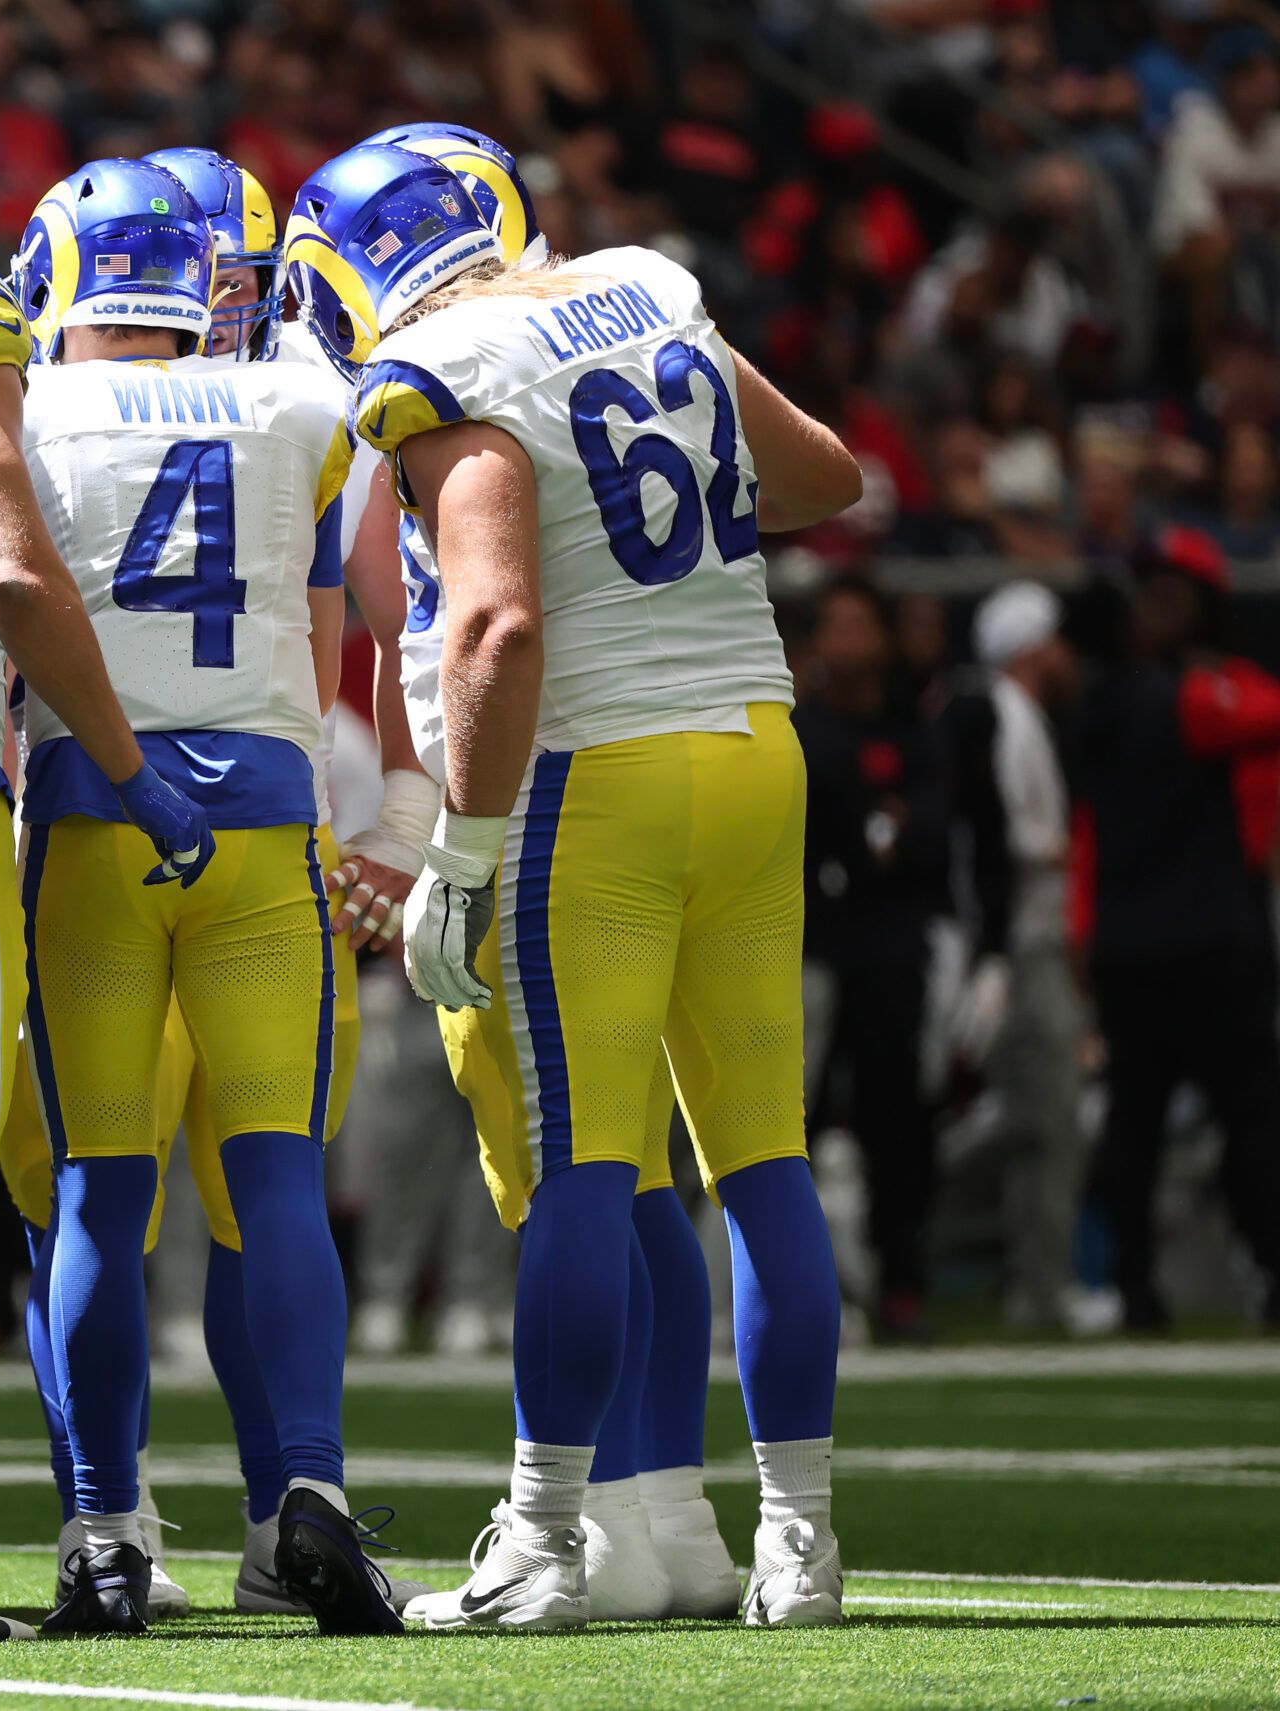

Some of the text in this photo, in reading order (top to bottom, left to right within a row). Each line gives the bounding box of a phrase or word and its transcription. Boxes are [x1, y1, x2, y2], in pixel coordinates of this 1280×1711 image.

[400, 238, 496, 299] LOS ANGELES
[92, 304, 204, 321] LOS ANGELES
[526, 279, 671, 363] LARSON
[108, 378, 242, 423] WINN
[569, 339, 761, 586] 62
[111, 439, 248, 670] 4
